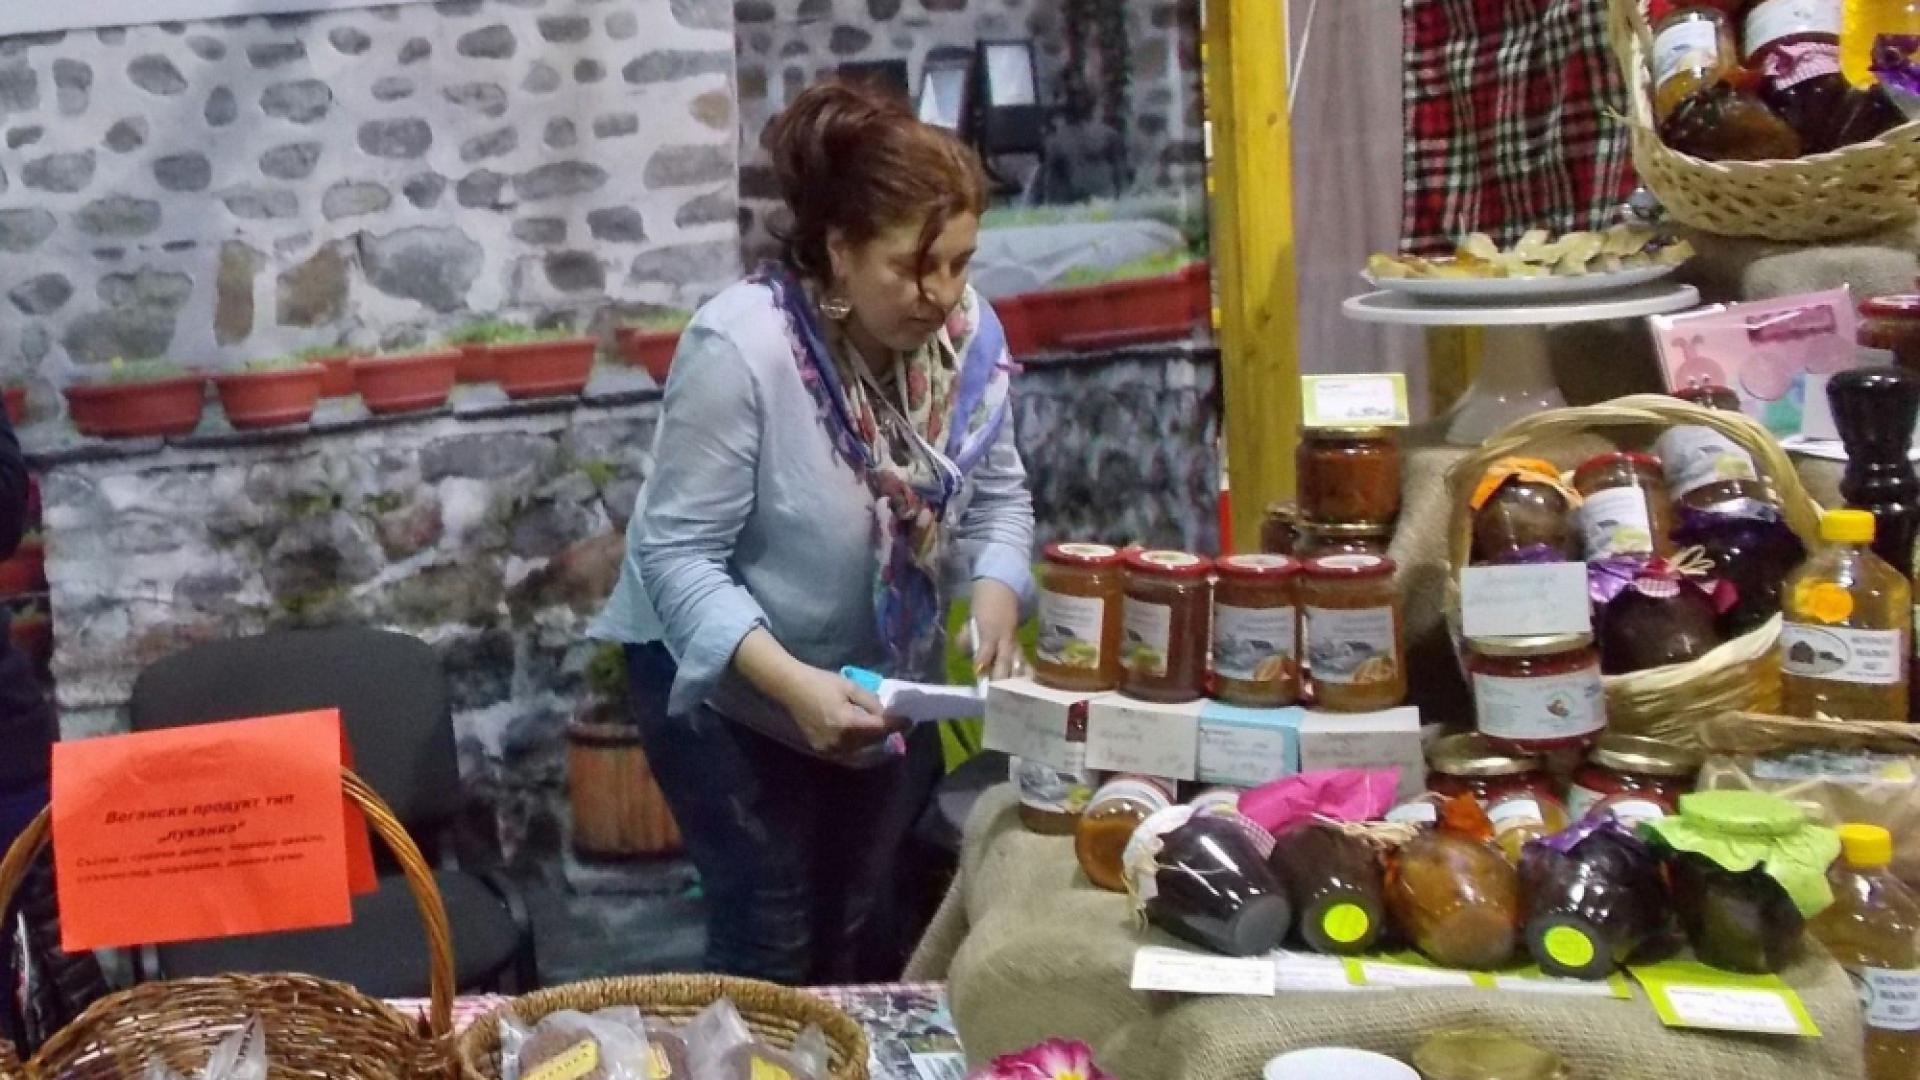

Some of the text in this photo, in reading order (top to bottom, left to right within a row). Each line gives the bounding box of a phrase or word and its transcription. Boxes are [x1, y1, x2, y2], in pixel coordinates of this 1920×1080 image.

[104, 793, 295, 825] Вегански продукт тип
